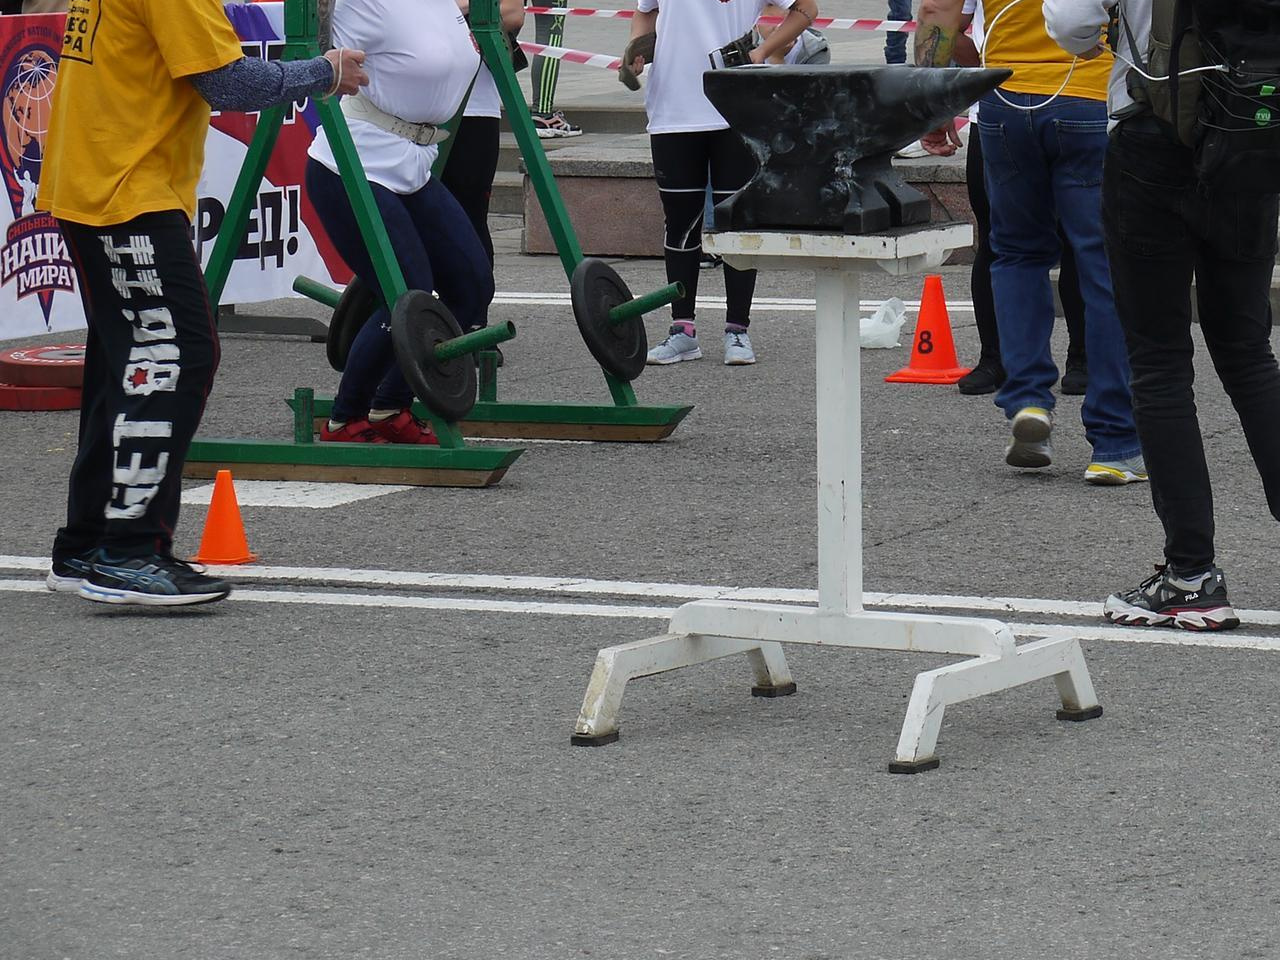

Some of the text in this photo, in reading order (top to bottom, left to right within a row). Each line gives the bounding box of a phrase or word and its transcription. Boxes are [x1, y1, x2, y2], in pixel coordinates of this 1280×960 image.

[3, 232, 72, 278] НАЦИ
[19, 265, 71, 293] МИРА
[918, 330, 933, 354] 8
[1184, 592, 1199, 602] FILA
